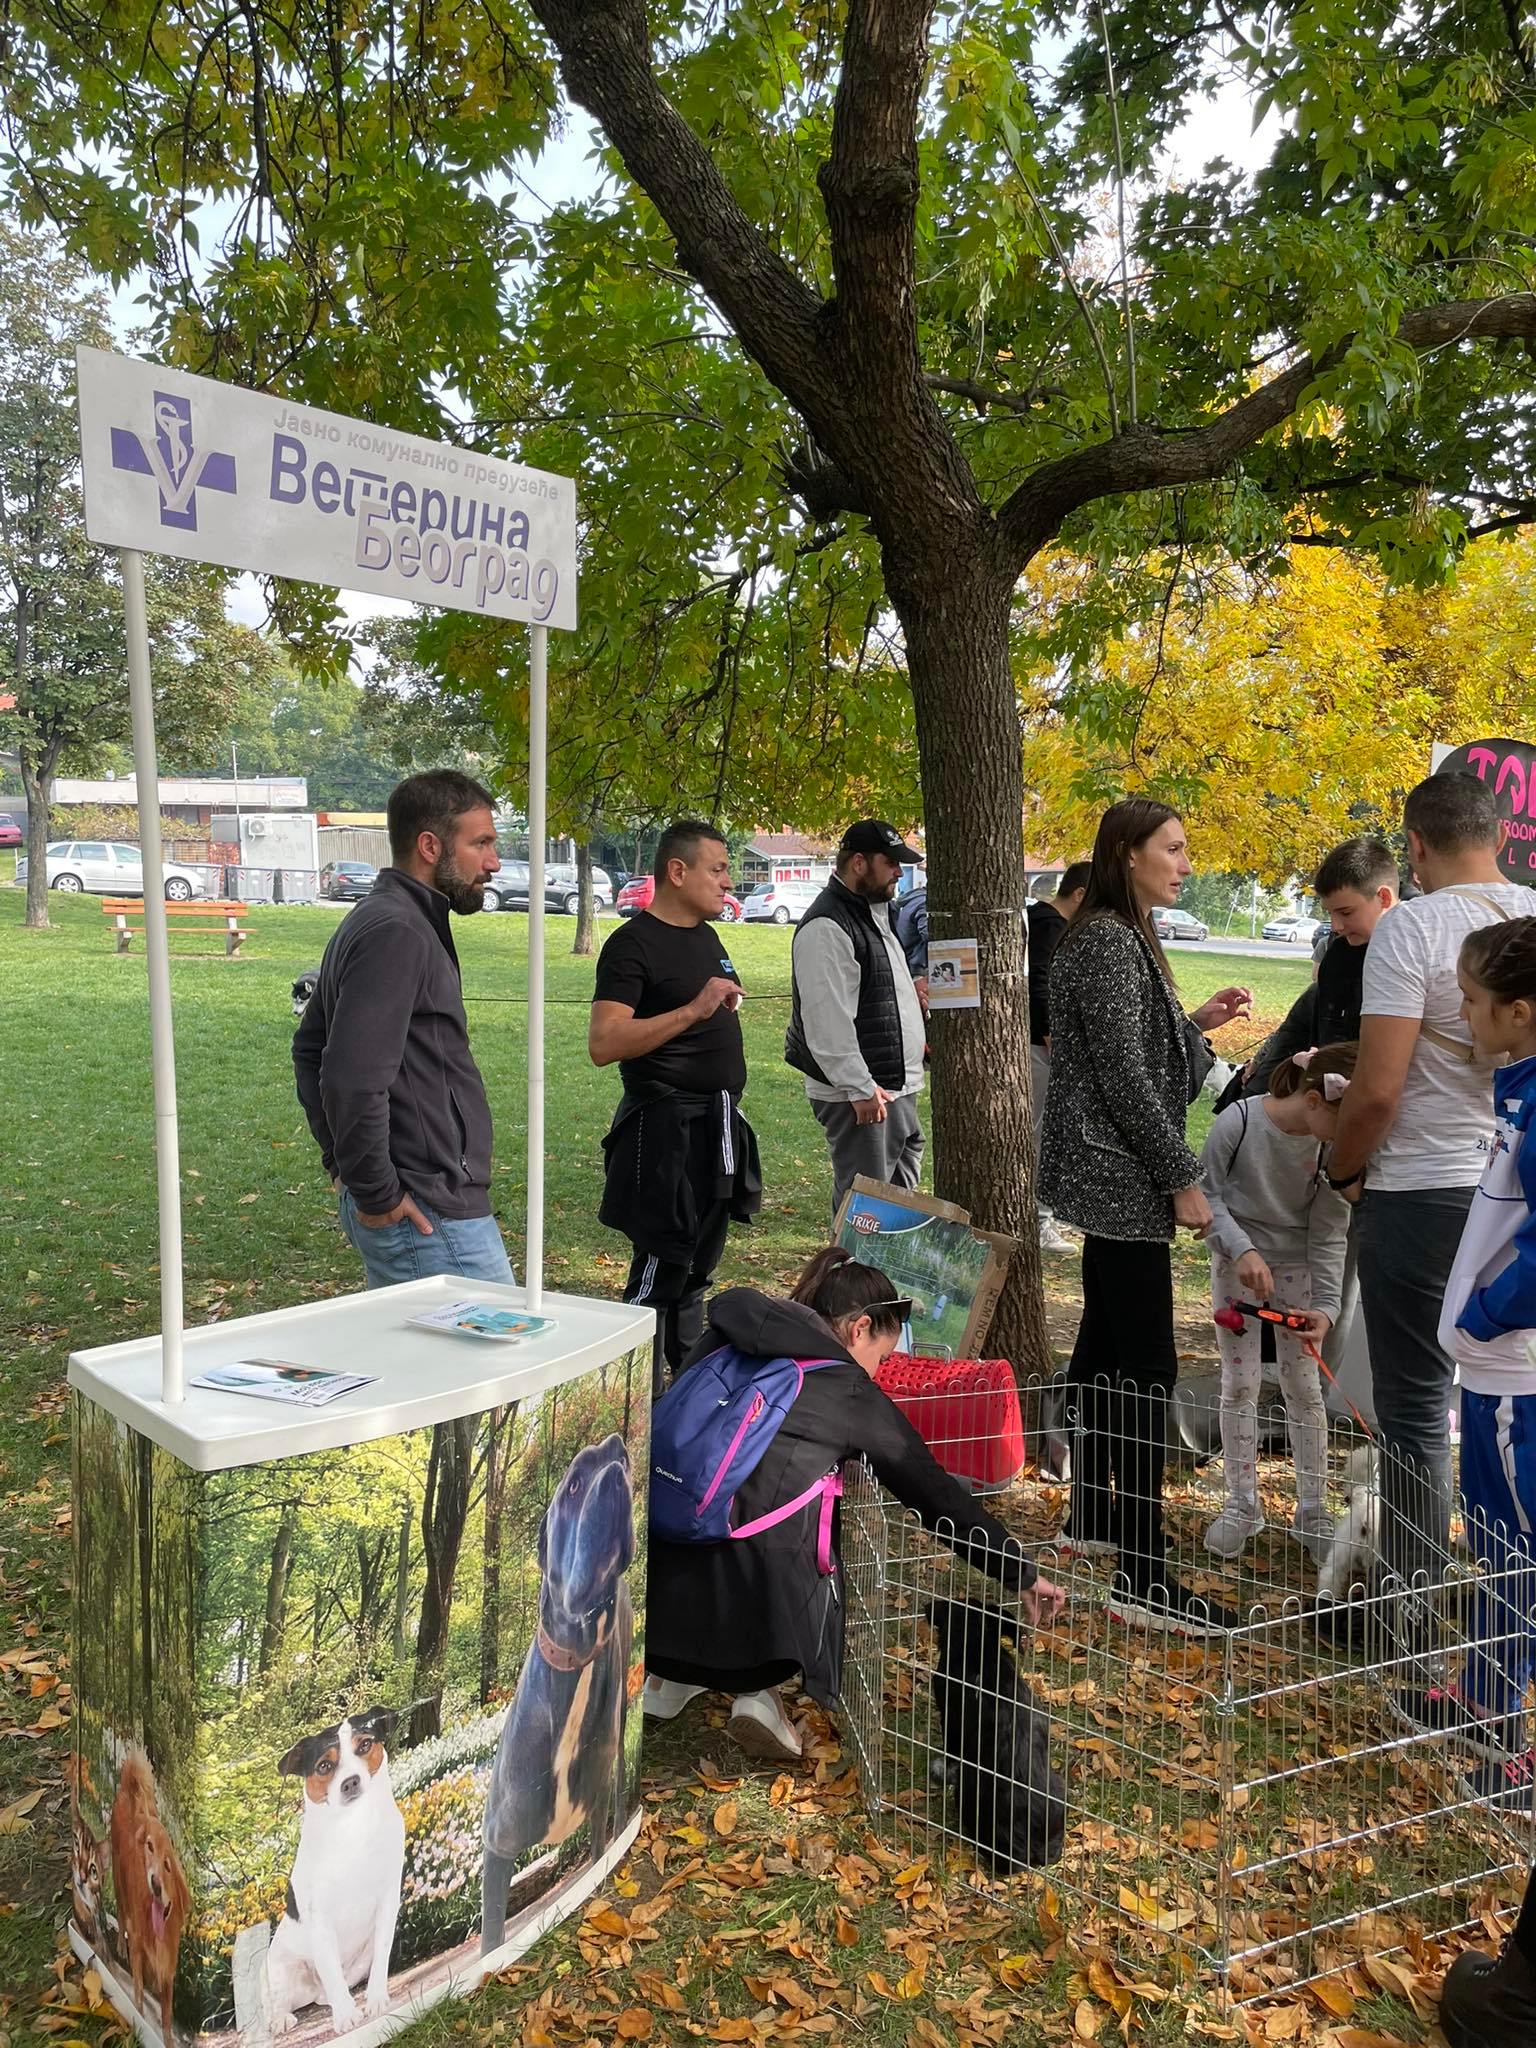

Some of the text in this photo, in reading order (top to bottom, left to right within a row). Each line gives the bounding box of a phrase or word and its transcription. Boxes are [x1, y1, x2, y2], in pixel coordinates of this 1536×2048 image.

[273, 408, 559, 501] Јавно комунално предузеће
[355, 500, 559, 622] Београд
[851, 1214, 880, 1233] TRIXIE
